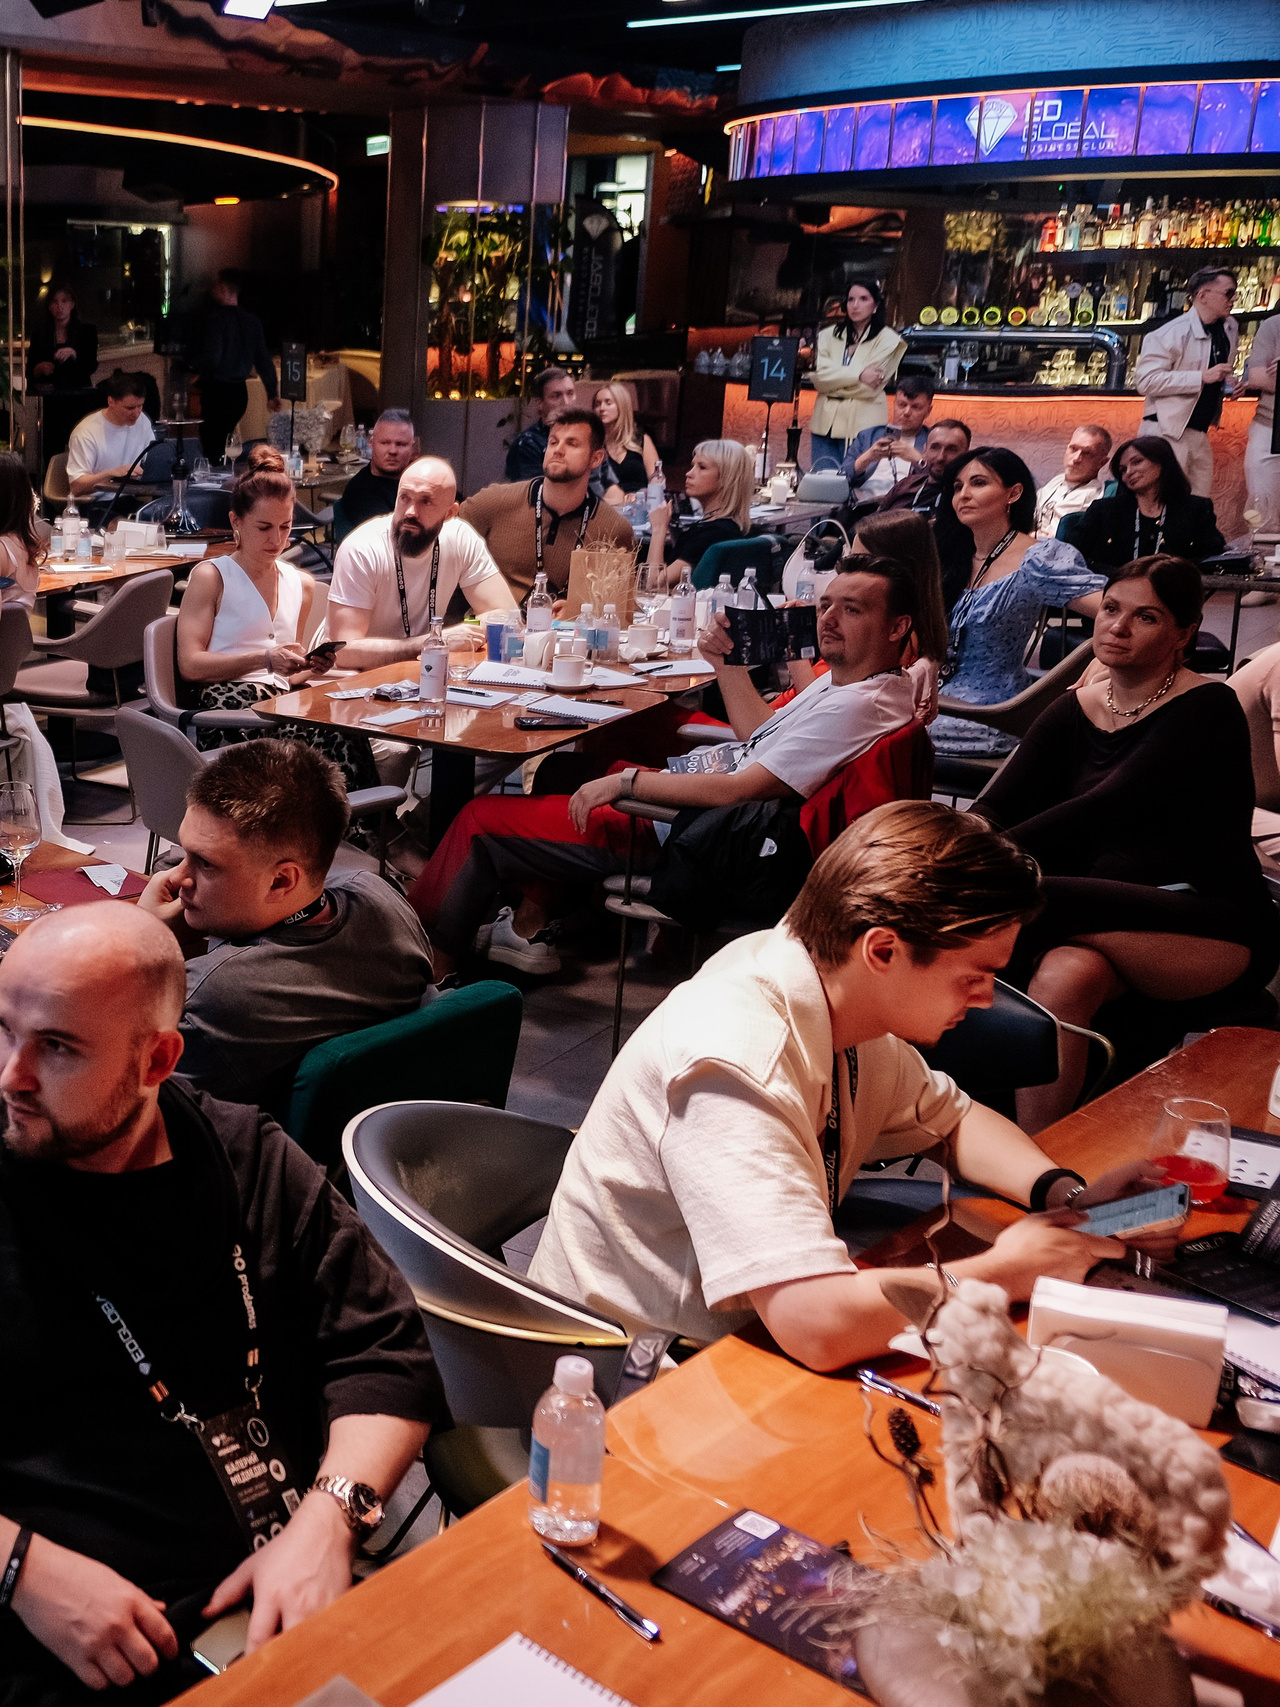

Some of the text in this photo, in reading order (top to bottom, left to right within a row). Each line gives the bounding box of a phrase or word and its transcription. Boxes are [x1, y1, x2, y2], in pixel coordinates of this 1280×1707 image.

[1025, 99, 1062, 122] ED
[1022, 121, 1118, 142] GLOBAL
[286, 360, 300, 381] 15
[760, 357, 787, 381] 14
